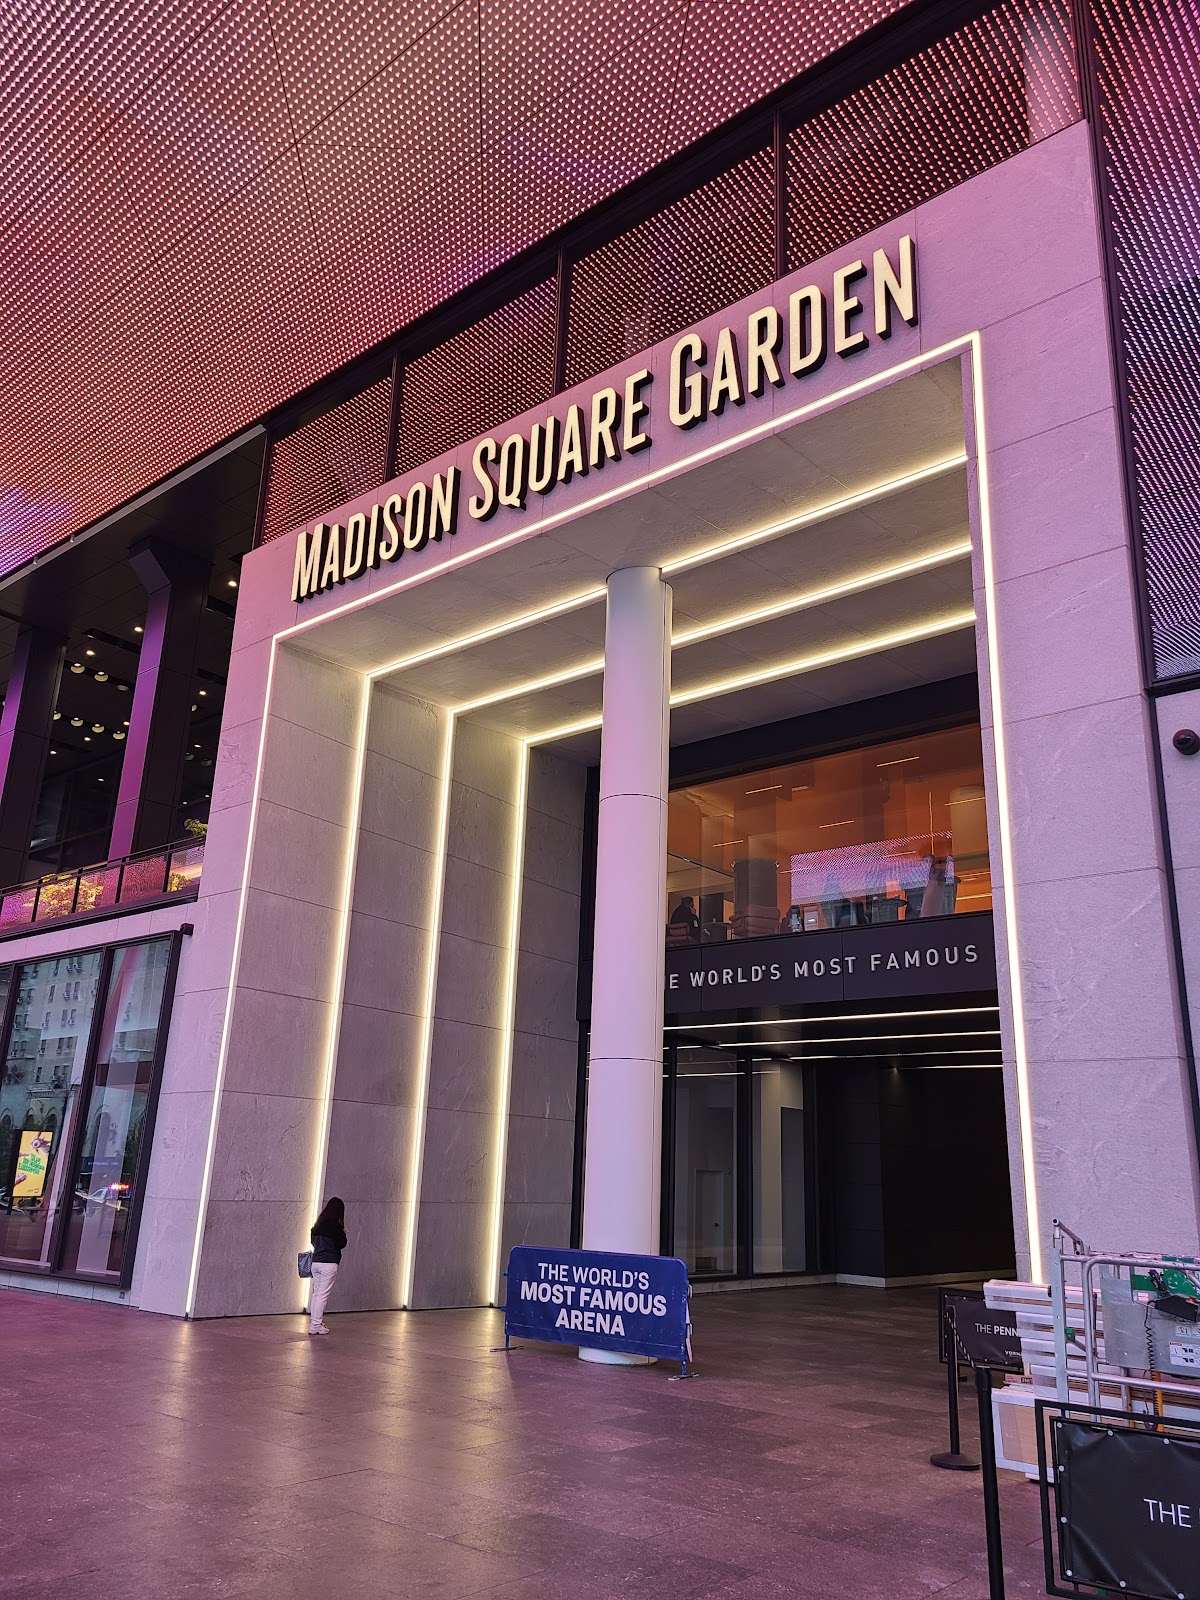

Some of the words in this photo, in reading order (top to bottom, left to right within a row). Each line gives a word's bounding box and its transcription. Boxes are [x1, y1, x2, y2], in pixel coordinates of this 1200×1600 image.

[290, 466, 460, 603] MADISON
[468, 369, 651, 522] SQUARE
[668, 235, 916, 429] GARDEN
[667, 973, 680, 989] E
[689, 963, 782, 988] WORLD'S
[794, 955, 857, 978] MOST
[870, 944, 979, 971] FAMOUS
[538, 1262, 570, 1283] THE
[572, 1265, 650, 1290] WORLD'S
[520, 1281, 576, 1306] MOST
[579, 1287, 667, 1317] FAMOUS
[555, 1308, 626, 1337] ARENA
[974, 1322, 992, 1335] THE
[1143, 1498, 1192, 1528] THE
